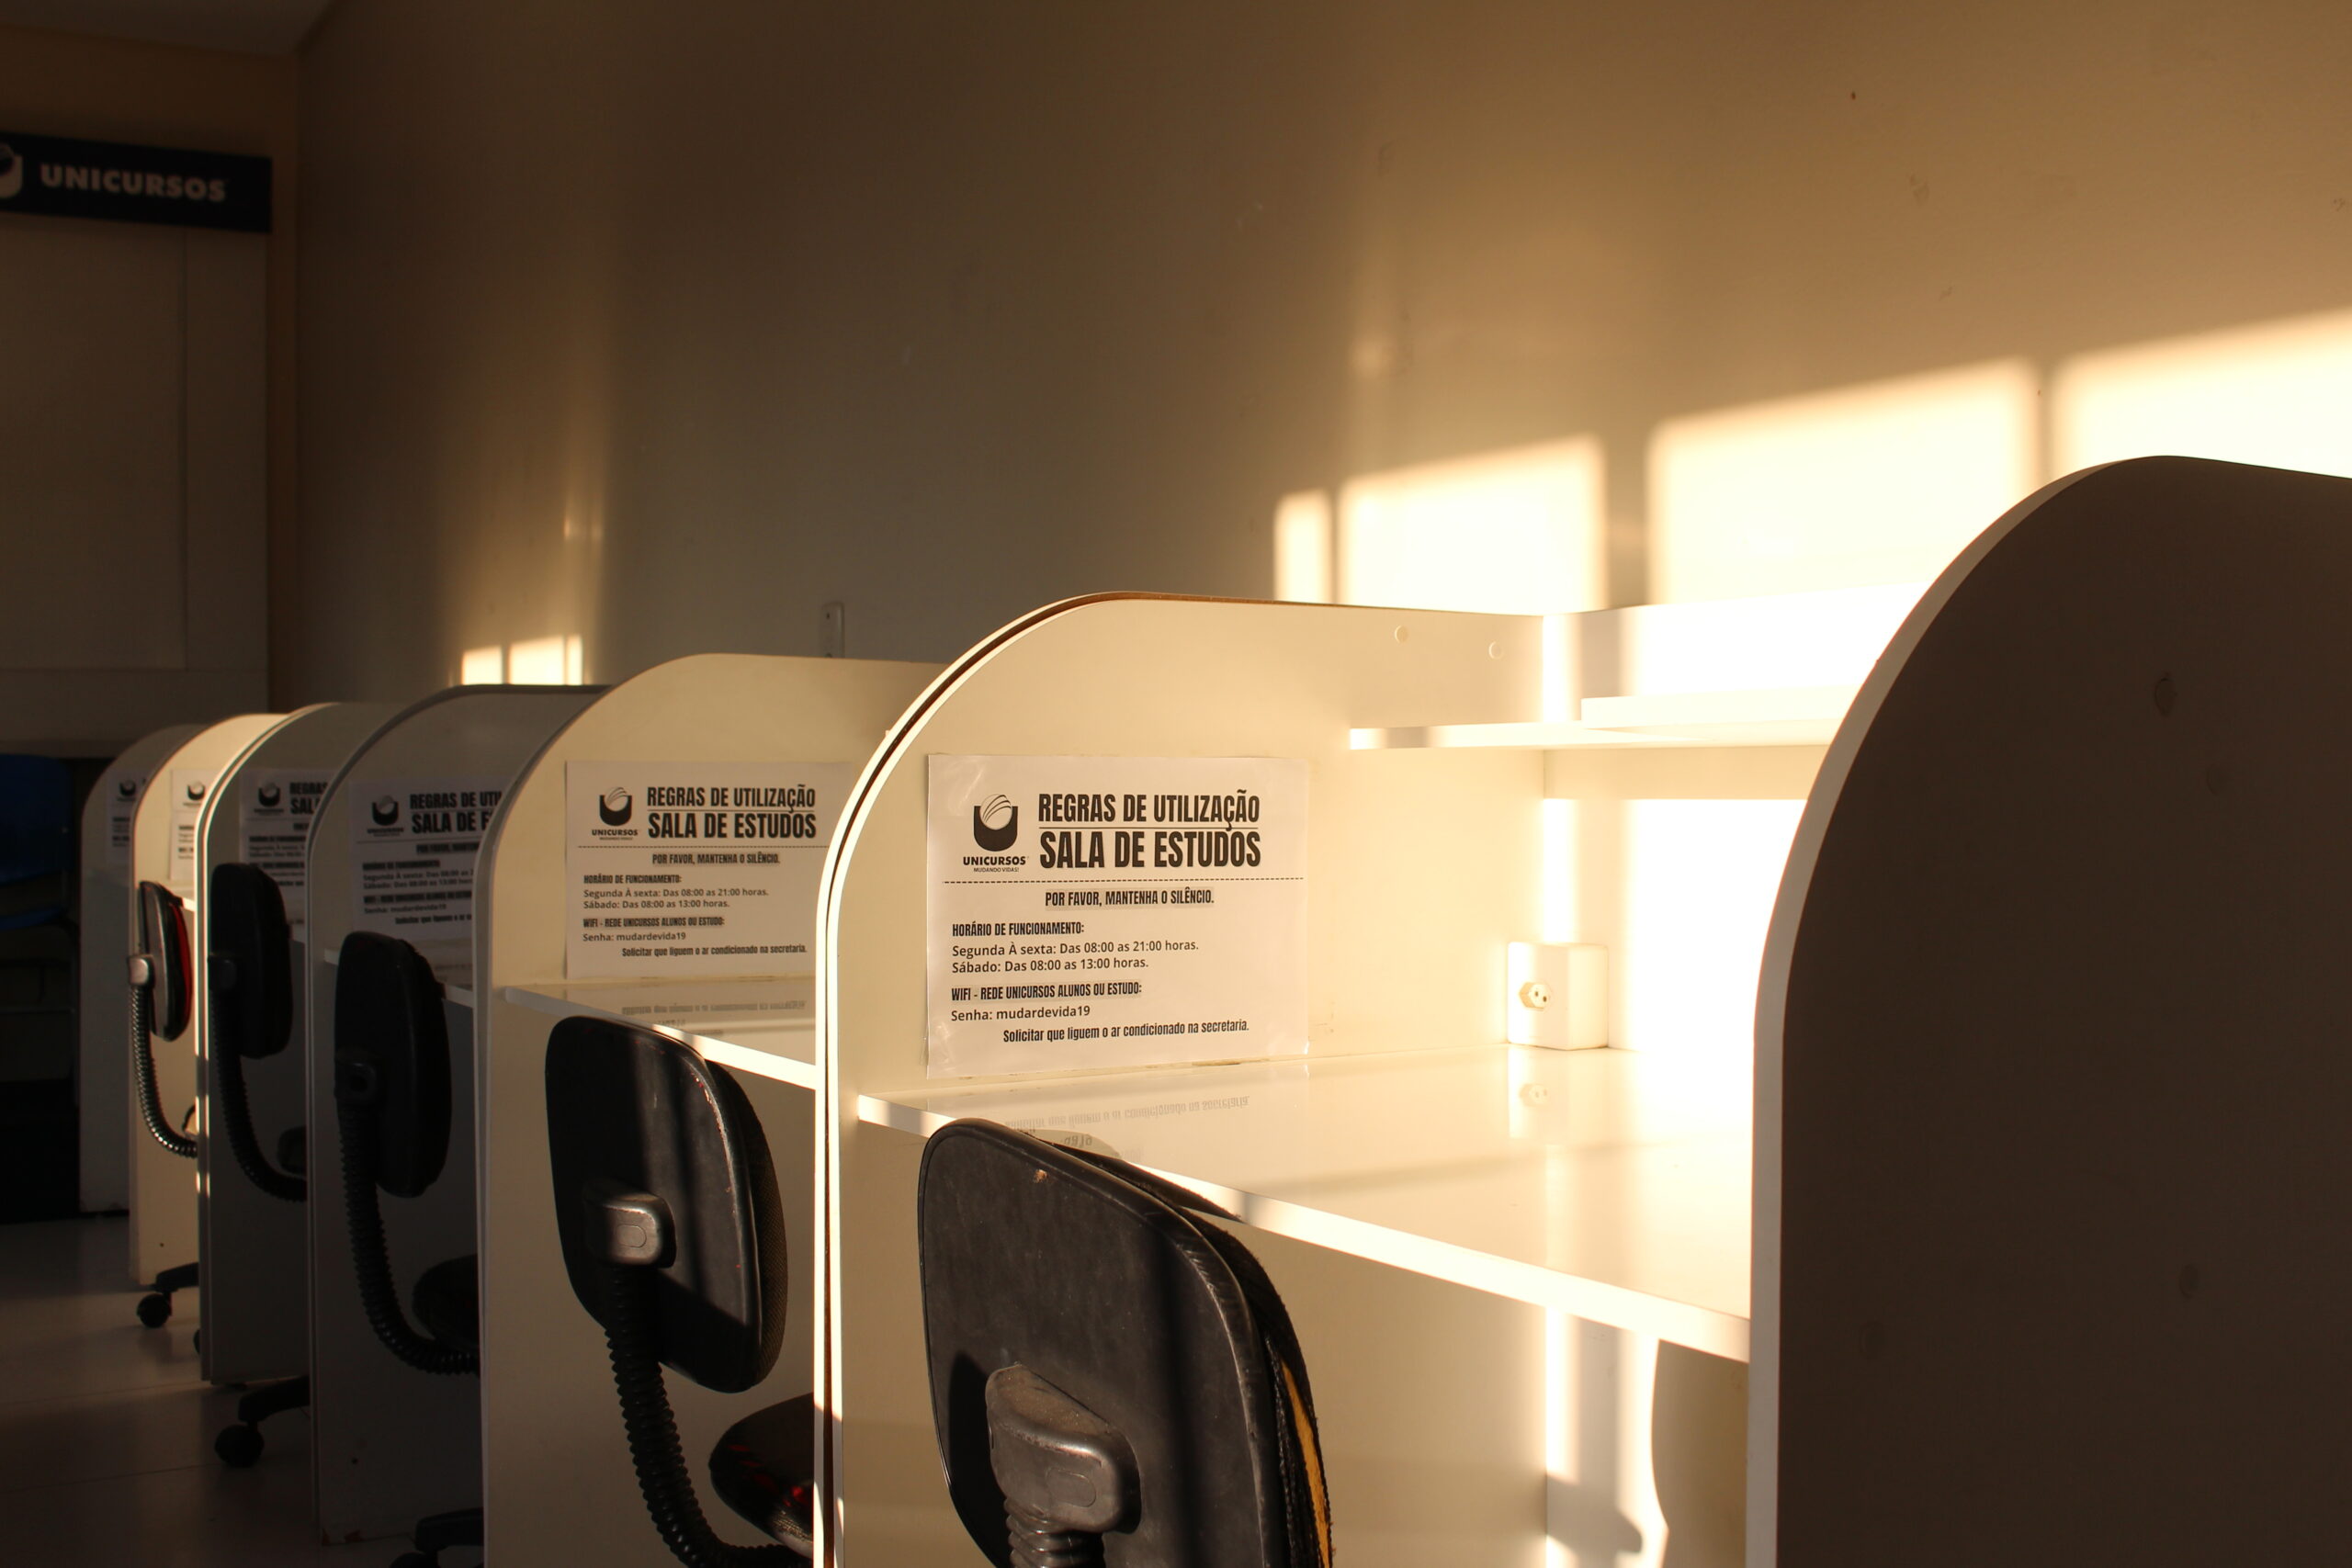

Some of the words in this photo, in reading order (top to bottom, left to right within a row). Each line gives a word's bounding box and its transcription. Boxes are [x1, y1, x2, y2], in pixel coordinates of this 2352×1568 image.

[40, 163, 227, 202] UNICURSOS
[291, 798, 320, 814] SAL
[410, 793, 458, 809] REGRAS
[461, 792, 476, 807] DE
[648, 787, 705, 807] REGRAS
[711, 788, 728, 807] DE
[734, 784, 816, 813] UTILIZAÇÃO
[1038, 794, 1115, 822] REGRAS
[1124, 795, 1147, 821] DE
[1154, 789, 1260, 831] UTILIZAÇÃO
[412, 813, 451, 833] SALA
[457, 812, 476, 831] DE
[649, 813, 696, 838] SALA
[705, 813, 727, 838] DE
[735, 813, 816, 838] ESTUDOS
[1040, 831, 1104, 869] SALA
[1115, 831, 1145, 867] DE
[1154, 829, 1261, 867] ESTUDOS
[653, 854, 667, 863] POR
[670, 854, 695, 865] FAVOR,
[698, 854, 737, 863] MANTENHA
[741, 854, 744, 863] O
[747, 852, 780, 863] SILÊNCIO.
[963, 856, 1025, 865] UNICURSOS
[583, 889, 623, 898] Segunda
[718, 888, 741, 897] 21:00
[1046, 893, 1065, 906] POR
[1069, 892, 1102, 908] FAVOR,
[1106, 891, 1158, 904] MANTENHA
[1161, 891, 1167, 904] O
[1170, 886, 1215, 904] SILÊNCIO.
[583, 900, 619, 908] Sábado:
[623, 900, 639, 908] Das
[583, 933, 614, 942] Senha:
[616, 932, 685, 941] mudardevida19
[953, 921, 991, 936] HORÁRIO
[995, 923, 1005, 935] DE
[1009, 922, 1084, 935] FUNCIONAMENTO:
[622, 948, 652, 957] Solicitar
[654, 948, 667, 957] que
[670, 947, 693, 956] liguem
[711, 945, 758, 954] condicionado
[770, 944, 807, 953] secretaria.
[953, 944, 1004, 959] Segunda
[1021, 944, 1056, 954] sexta:
[1060, 943, 1080, 953] Das
[1084, 942, 1114, 953] 08:00
[1134, 941, 1161, 952] 21:00
[1166, 941, 1198, 950] horas.
[952, 961, 1001, 973] Sábado:
[1005, 961, 1026, 972] Das
[1031, 960, 1060, 971] 08:00
[1064, 962, 1077, 970] as
[1080, 958, 1110, 969] 13:00
[1114, 957, 1148, 968] horas.
[952, 988, 970, 1000] WIFI
[981, 987, 1003, 999] REDE
[1007, 986, 1055, 998] UNICURSOS
[1058, 984, 1091, 997] ALUNOS
[1094, 984, 1104, 996] OU
[1108, 983, 1141, 995] ESTUDO:
[952, 1010, 992, 1021] Senha:
[997, 1006, 1090, 1020] mudardevida19
[1003, 1029, 1044, 1042] Solicitar
[1047, 1030, 1065, 1042] que
[1068, 1027, 1099, 1040] liguem
[1102, 1027, 1108, 1037] o
[1112, 1027, 1121, 1037] ar
[1124, 1022, 1185, 1036] condicionado
[1188, 1023, 1198, 1032] na
[1202, 1020, 1249, 1032] secretaria.
